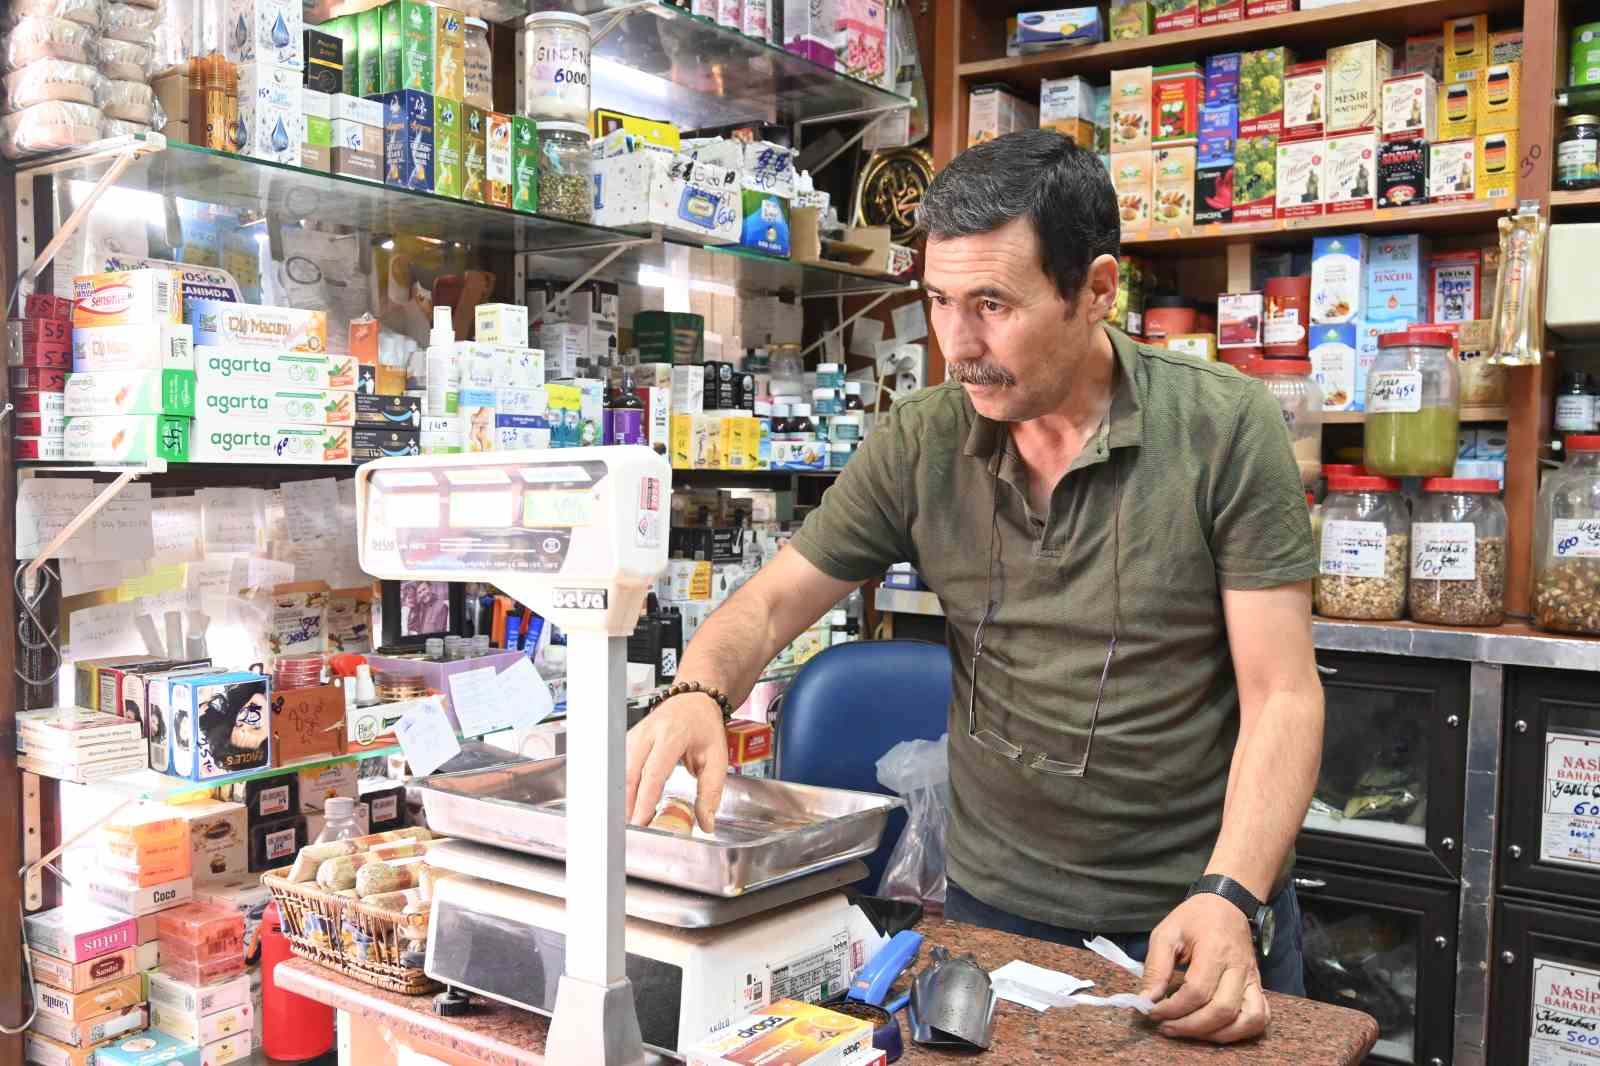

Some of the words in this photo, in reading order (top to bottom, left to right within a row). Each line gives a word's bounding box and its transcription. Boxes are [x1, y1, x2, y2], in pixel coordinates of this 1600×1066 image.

[209, 357, 271, 377] agarta
[207, 394, 269, 414] agarta
[210, 431, 271, 451] agarta
[153, 888, 176, 904] Coco
[84, 929, 129, 952] Lotus
[95, 962, 119, 978] Sandal
[737, 1015, 783, 1039] drops
